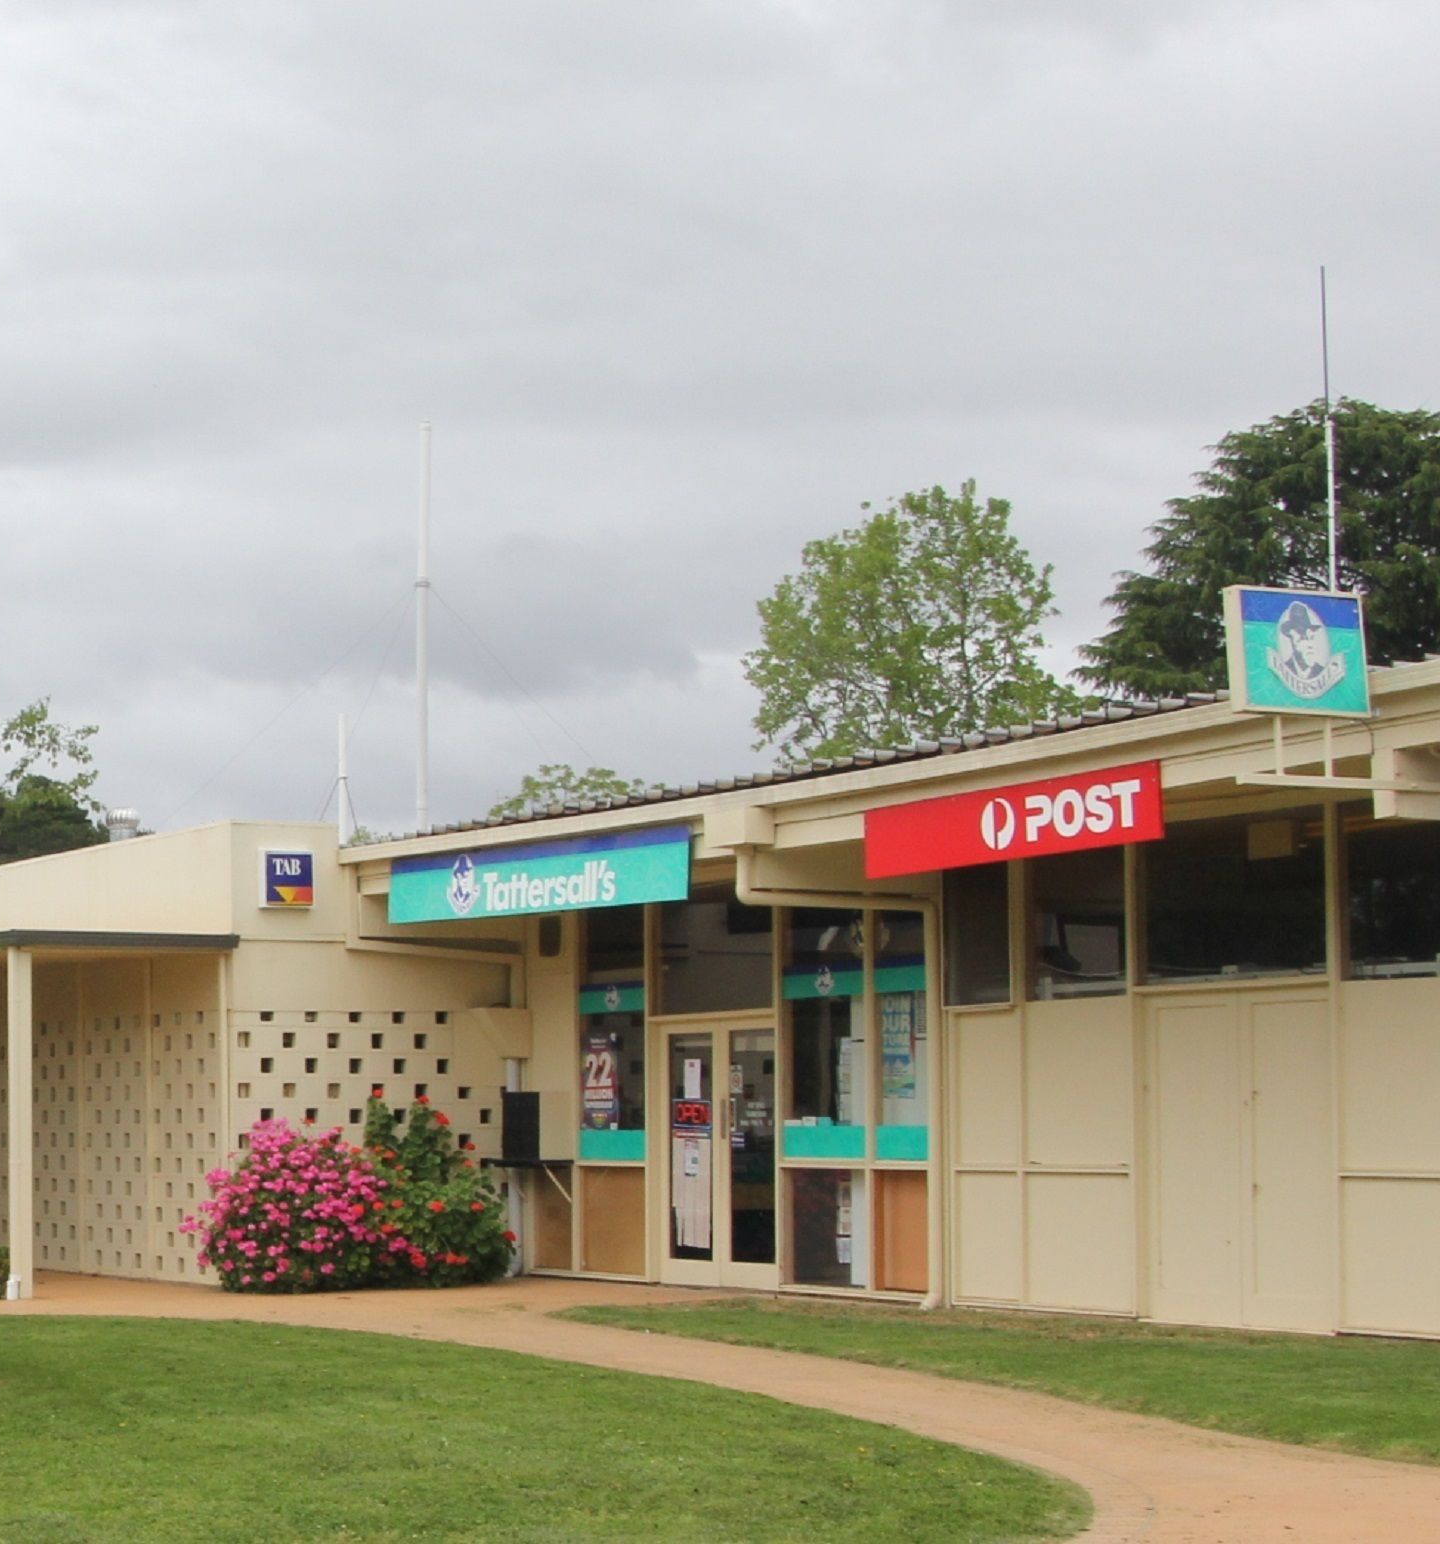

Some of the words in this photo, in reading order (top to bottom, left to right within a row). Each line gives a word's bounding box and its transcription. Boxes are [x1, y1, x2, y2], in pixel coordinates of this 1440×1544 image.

[1025, 779, 1141, 842] POST
[272, 858, 301, 875] TAB
[483, 860, 616, 912] Tattersall's
[586, 1052, 612, 1087] 22
[676, 1103, 709, 1124] OPEN
